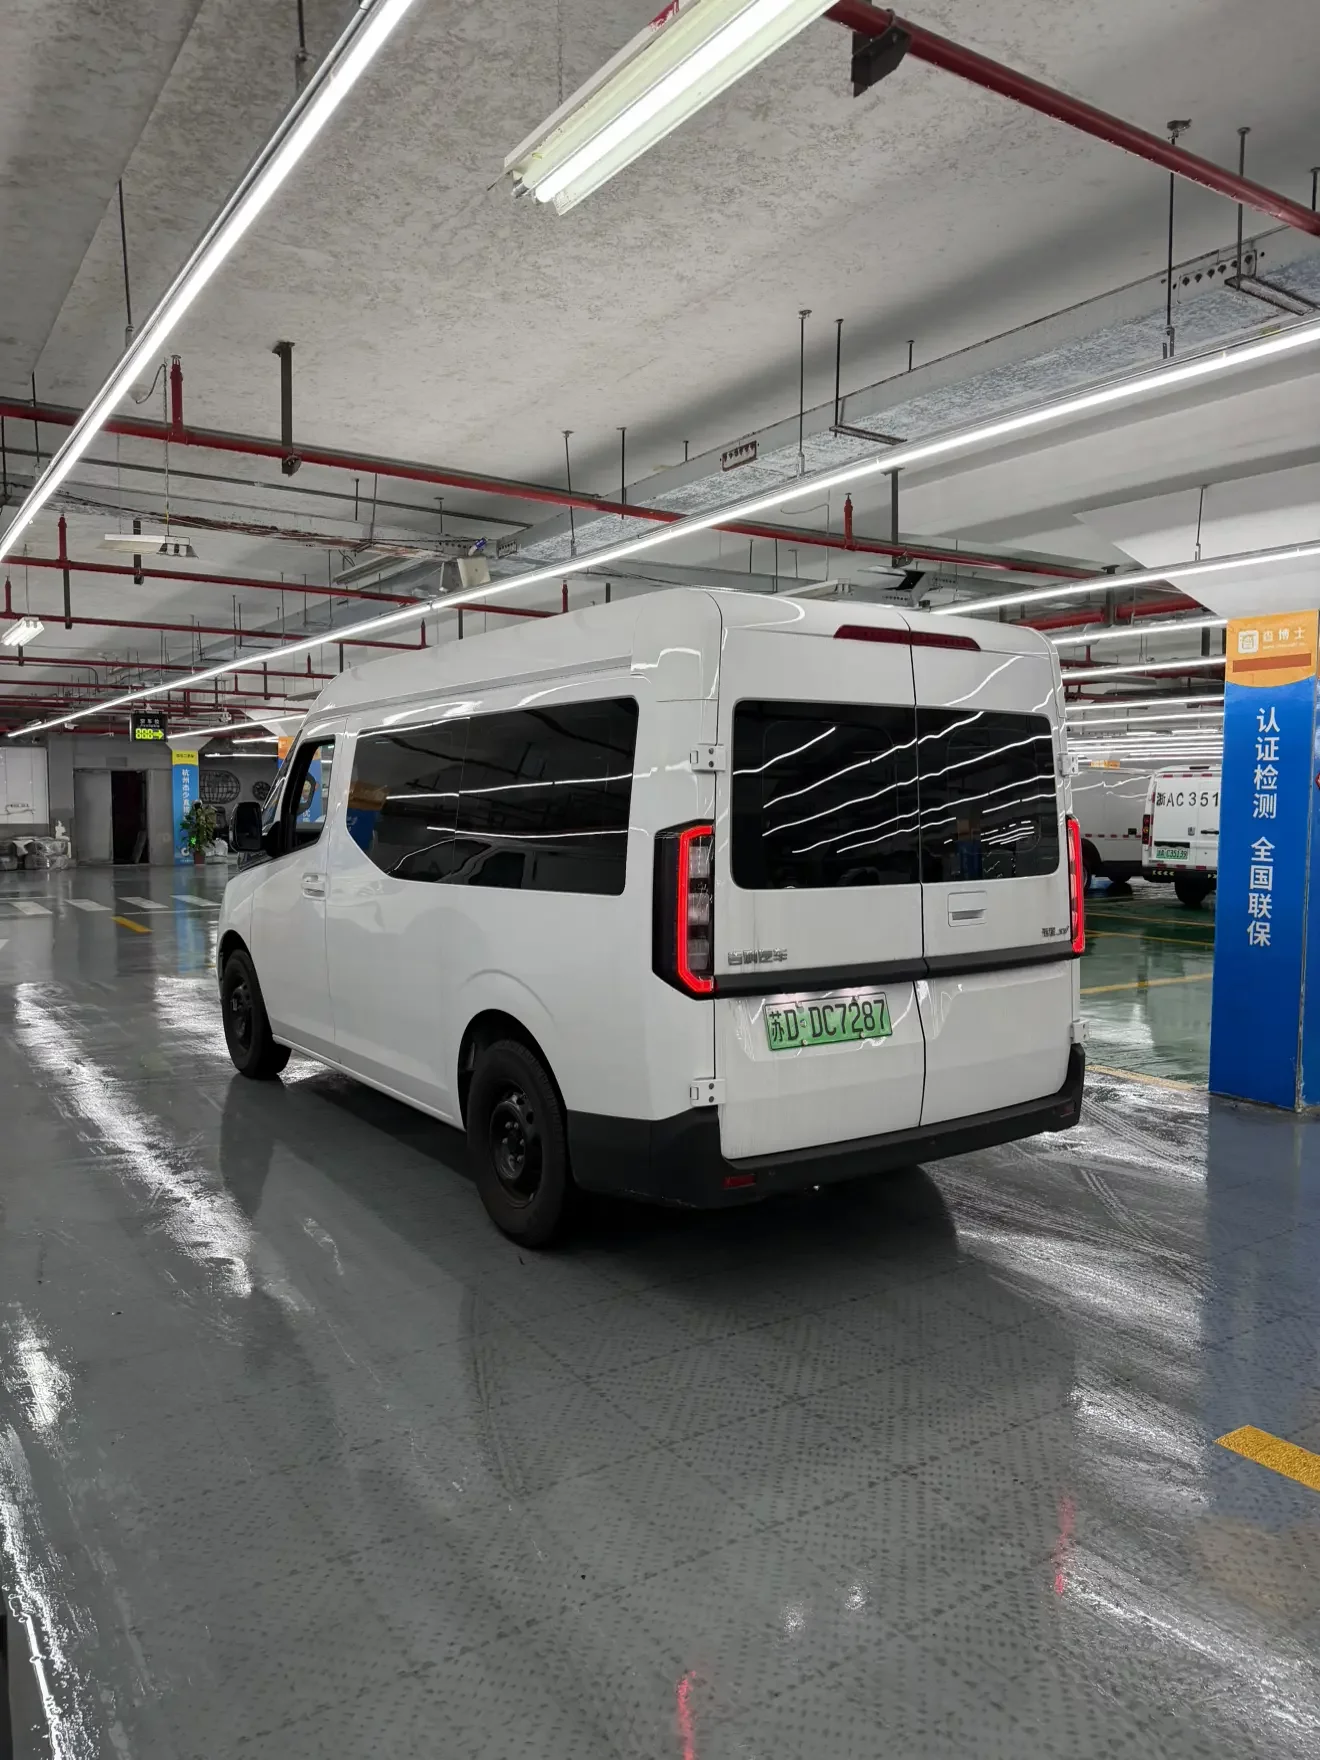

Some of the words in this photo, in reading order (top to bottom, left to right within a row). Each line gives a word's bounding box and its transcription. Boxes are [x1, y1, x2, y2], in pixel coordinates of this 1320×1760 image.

[1252, 707, 1280, 819] 认证检测
[1247, 836, 1276, 947] 全国联保
